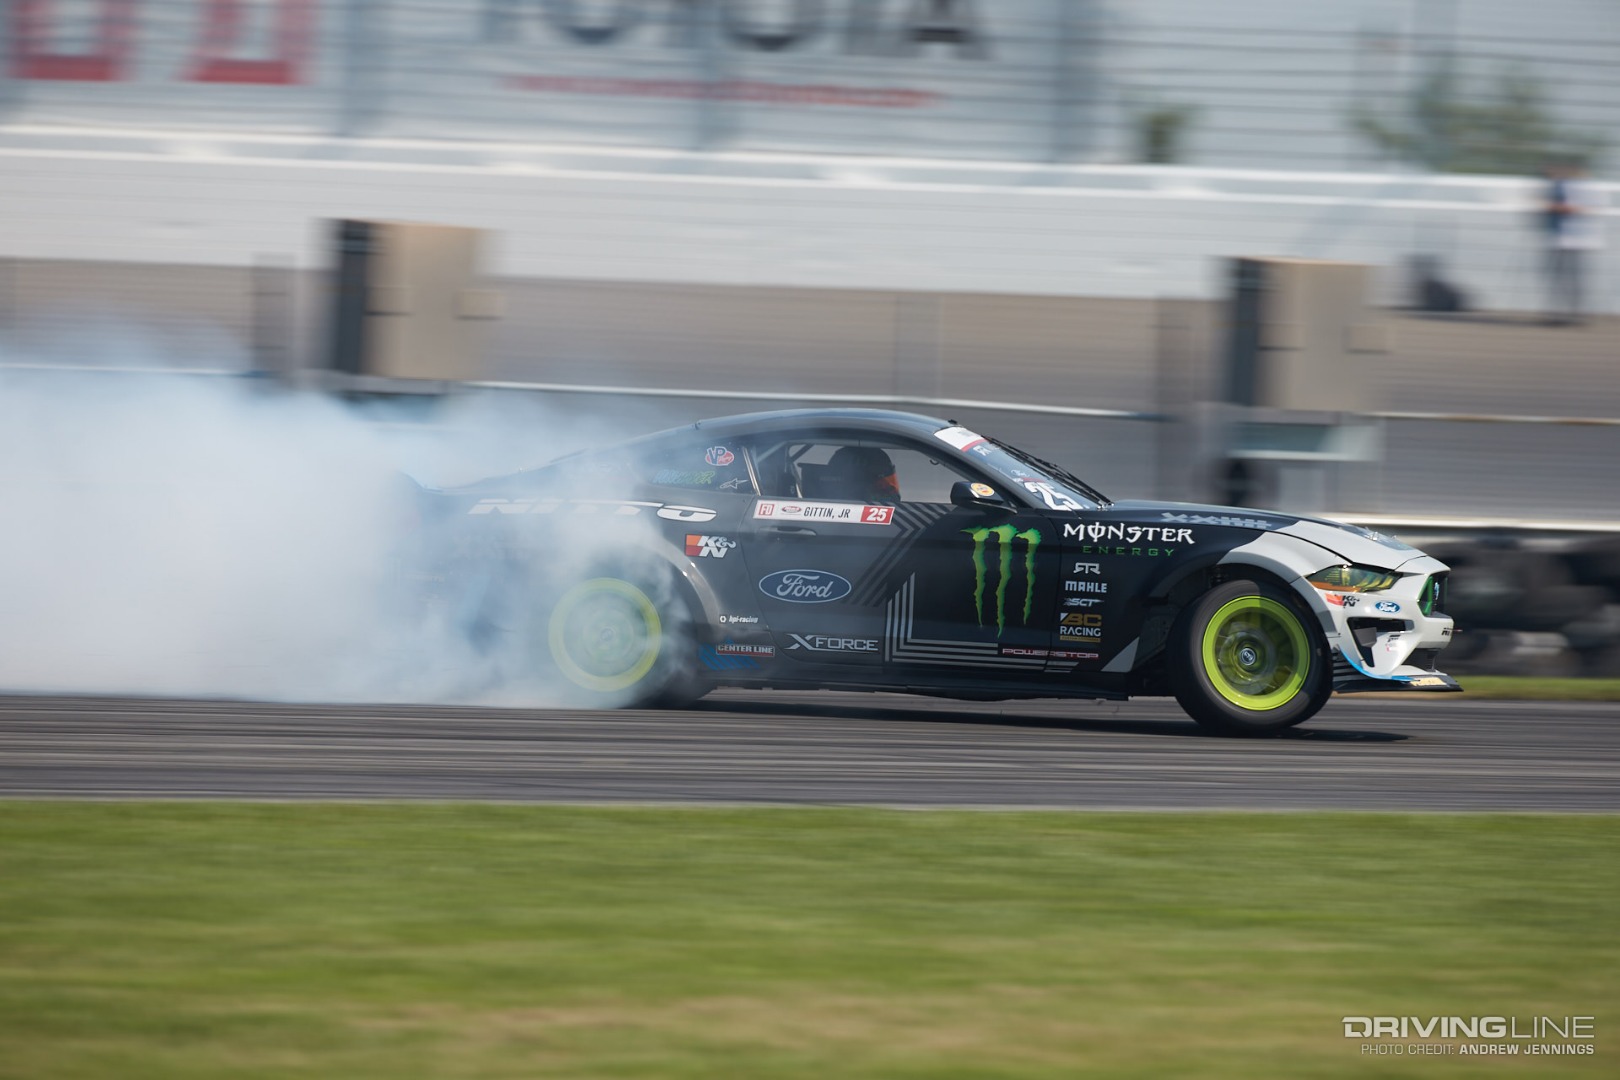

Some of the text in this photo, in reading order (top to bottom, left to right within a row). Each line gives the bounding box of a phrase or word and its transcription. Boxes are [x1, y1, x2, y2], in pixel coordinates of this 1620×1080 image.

[706, 446, 727, 465] VP
[760, 504, 773, 516] FD
[803, 506, 835, 519] GITTIN,
[838, 508, 851, 518] JR
[866, 507, 888, 522] 25
[1082, 545, 1175, 557] ENERGY
[1073, 562, 1101, 574] RTR
[776, 573, 834, 598] Ford
[1065, 580, 1108, 593] MAHLE
[1068, 598, 1099, 608] SCT
[1061, 613, 1103, 627] BC
[1059, 626, 1102, 637] RACING
[717, 644, 774, 654] CENTER LINE
[784, 633, 879, 652] XFORCE
